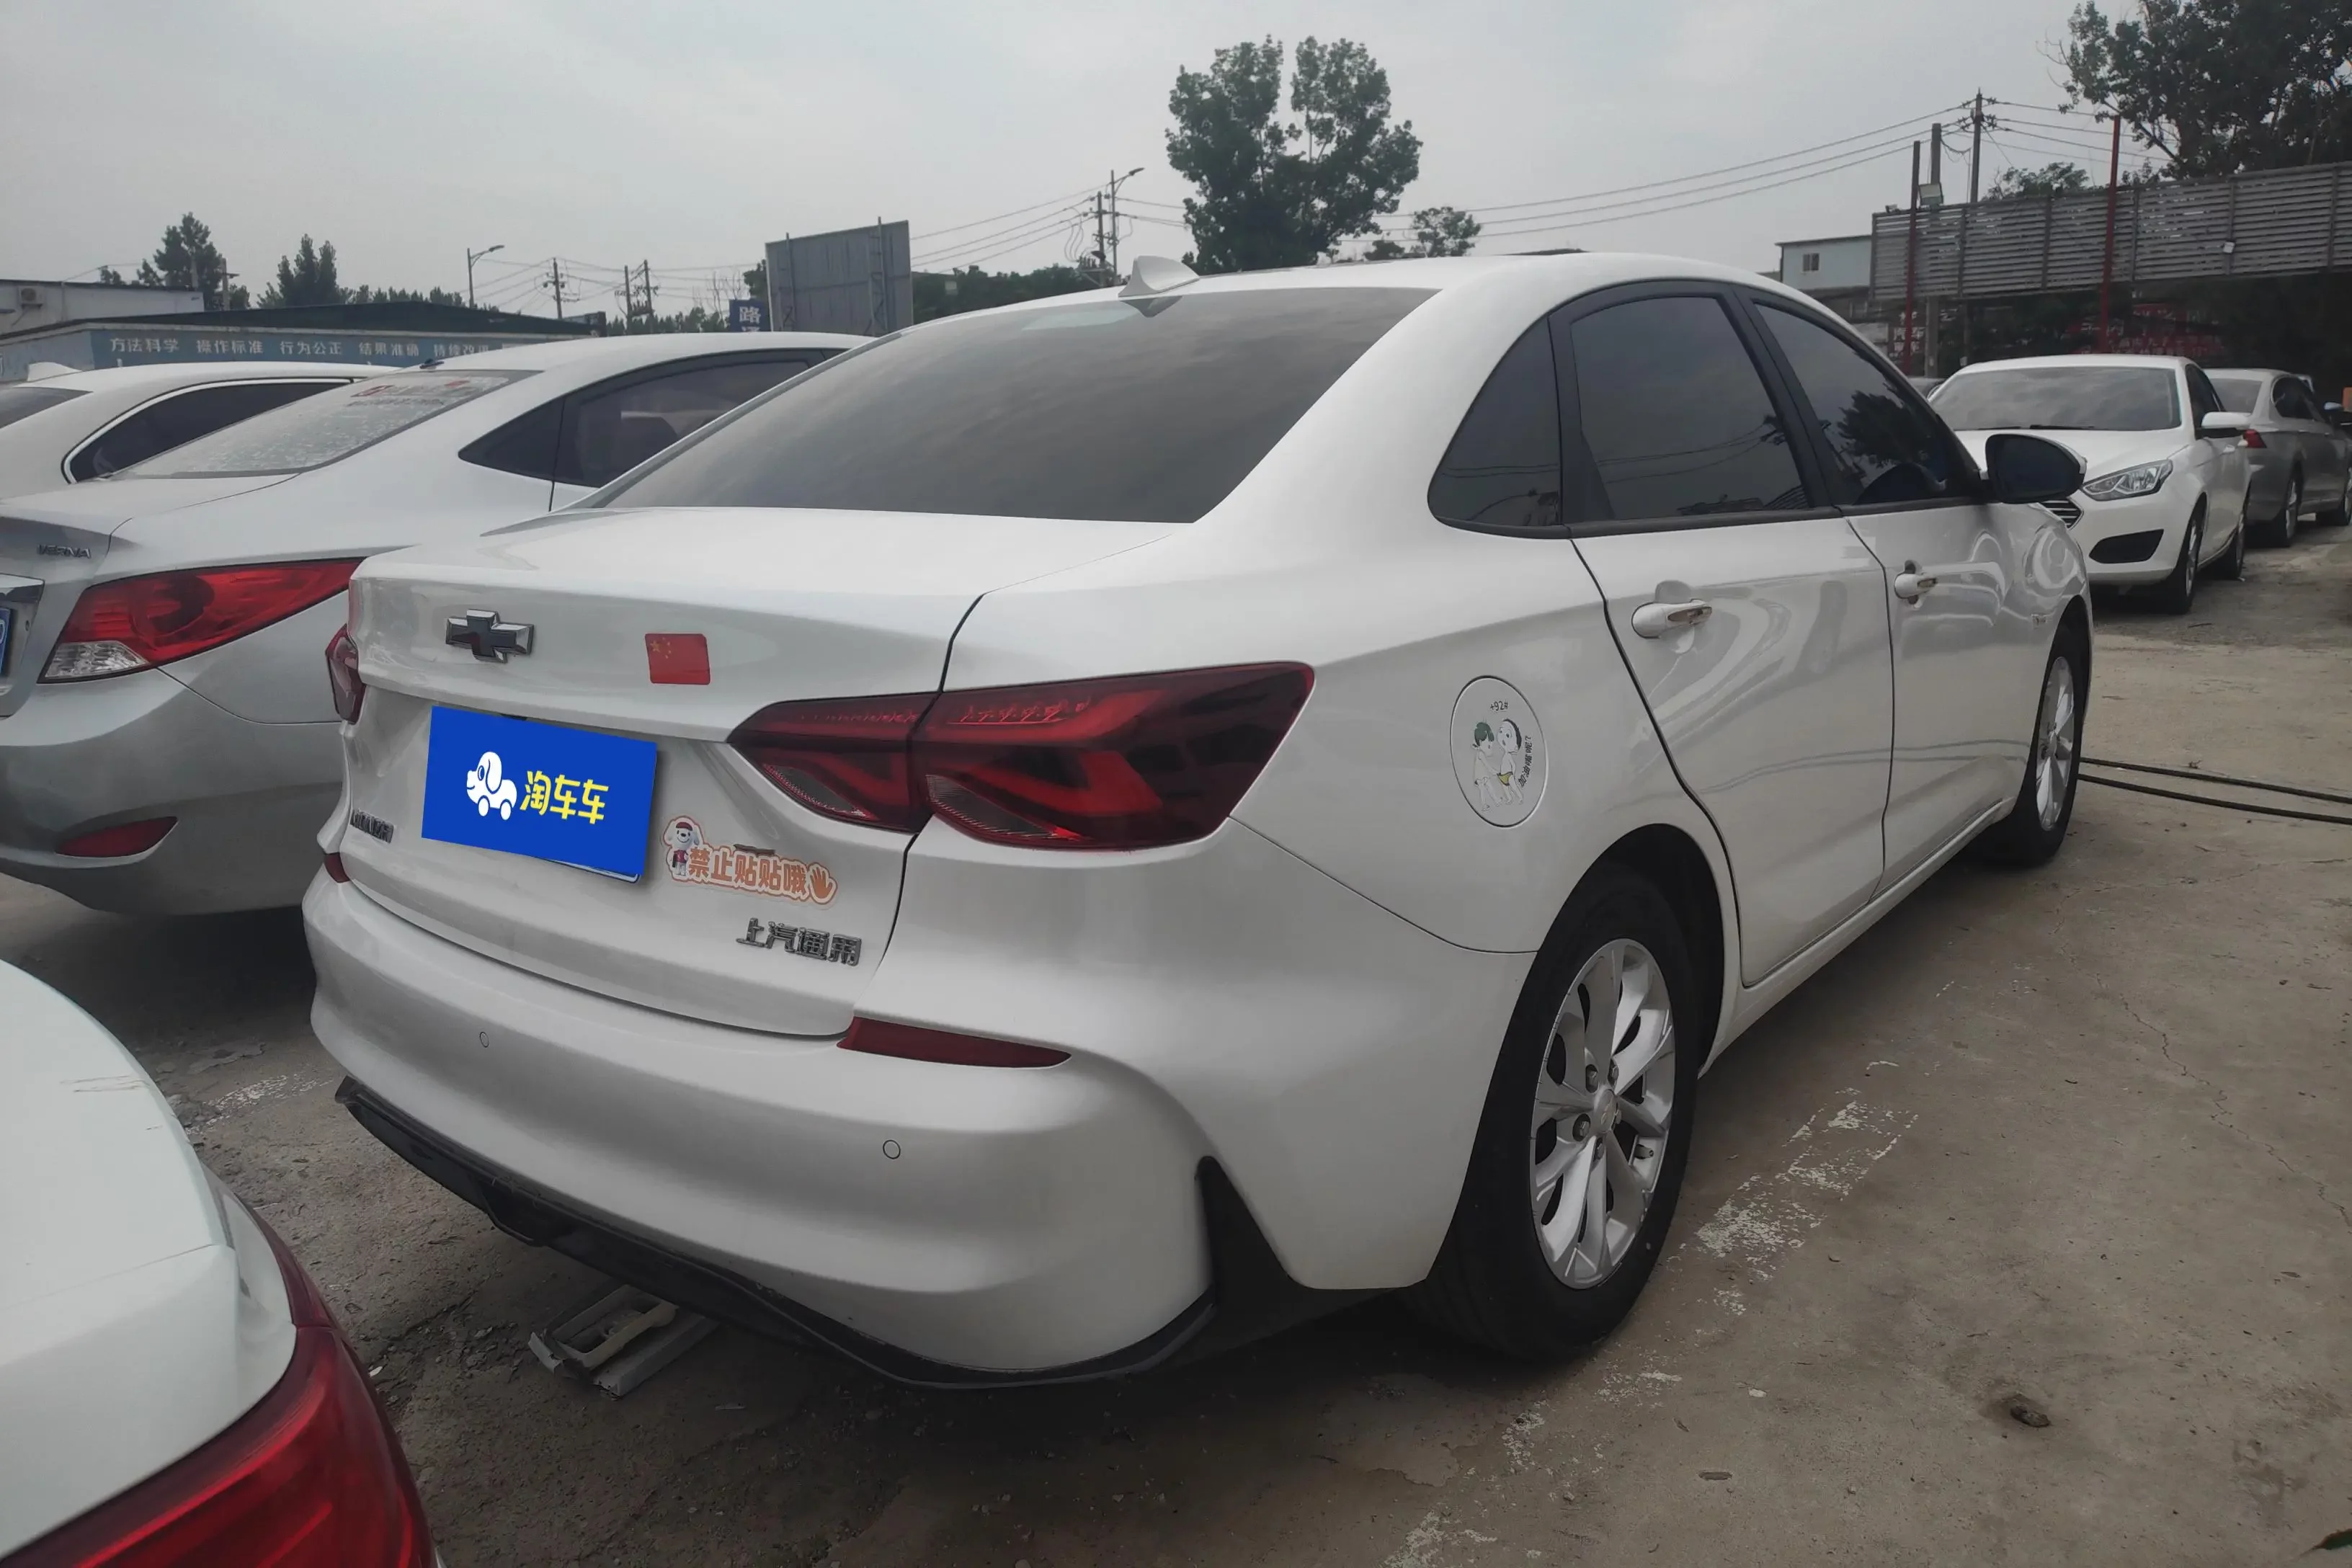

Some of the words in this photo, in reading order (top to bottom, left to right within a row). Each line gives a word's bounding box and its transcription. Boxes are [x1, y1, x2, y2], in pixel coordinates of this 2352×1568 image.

[110, 337, 179, 353] 方法科学
[197, 339, 264, 354] 操作标准
[280, 340, 342, 355] 行为公正
[359, 342, 419, 357] 结果准确
[37, 544, 92, 559] VERNA
[689, 847, 807, 895] 禁止贴贴哦
[736, 917, 862, 966] 上汽通用
